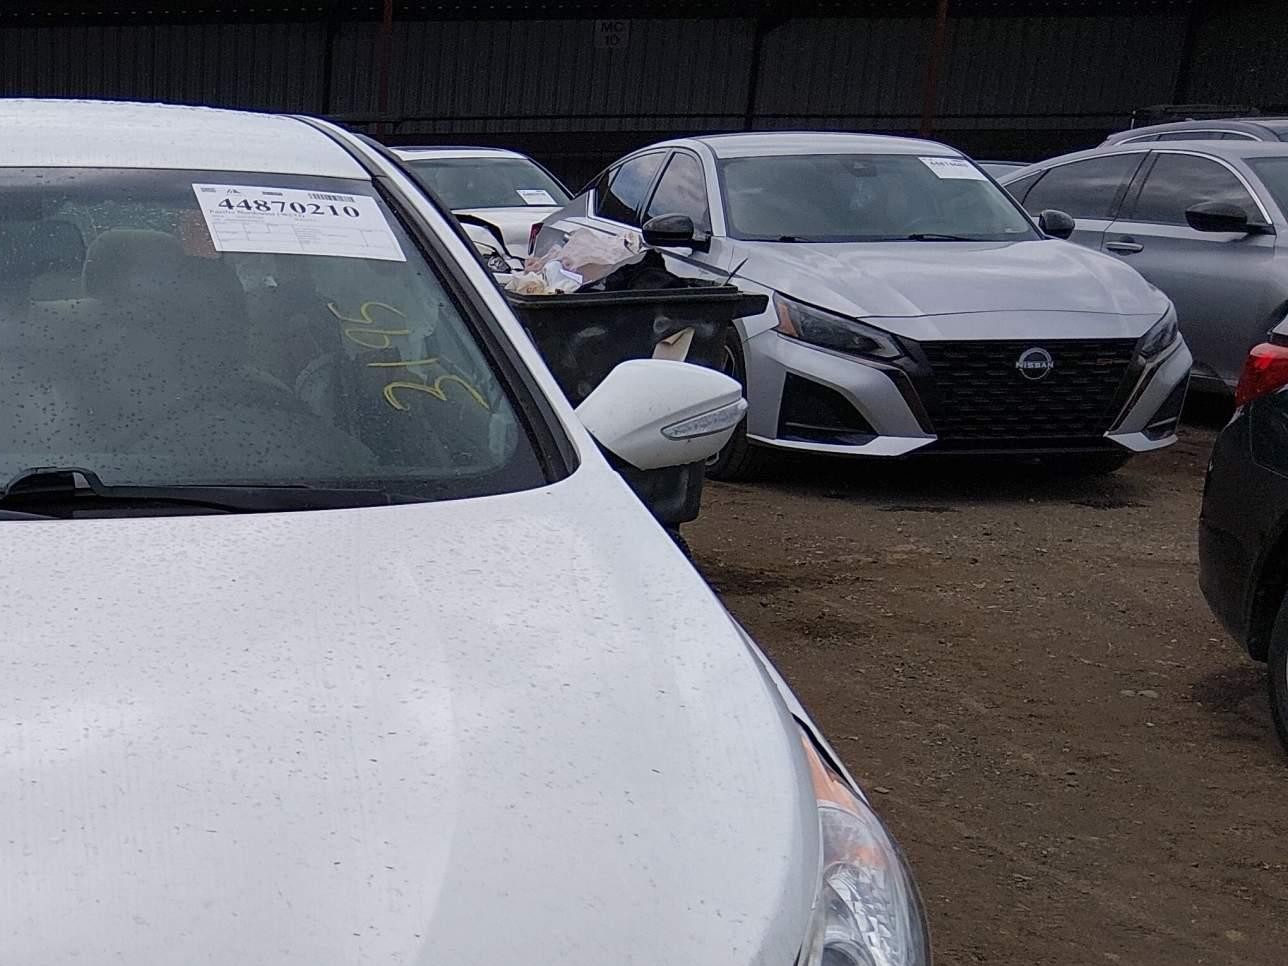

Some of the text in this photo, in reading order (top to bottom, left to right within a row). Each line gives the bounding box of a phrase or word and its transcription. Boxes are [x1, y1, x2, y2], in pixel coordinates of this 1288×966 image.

[601, 21, 624, 33] MC
[217, 198, 361, 219] 44870210
[1015, 360, 1054, 369] NISSAN
